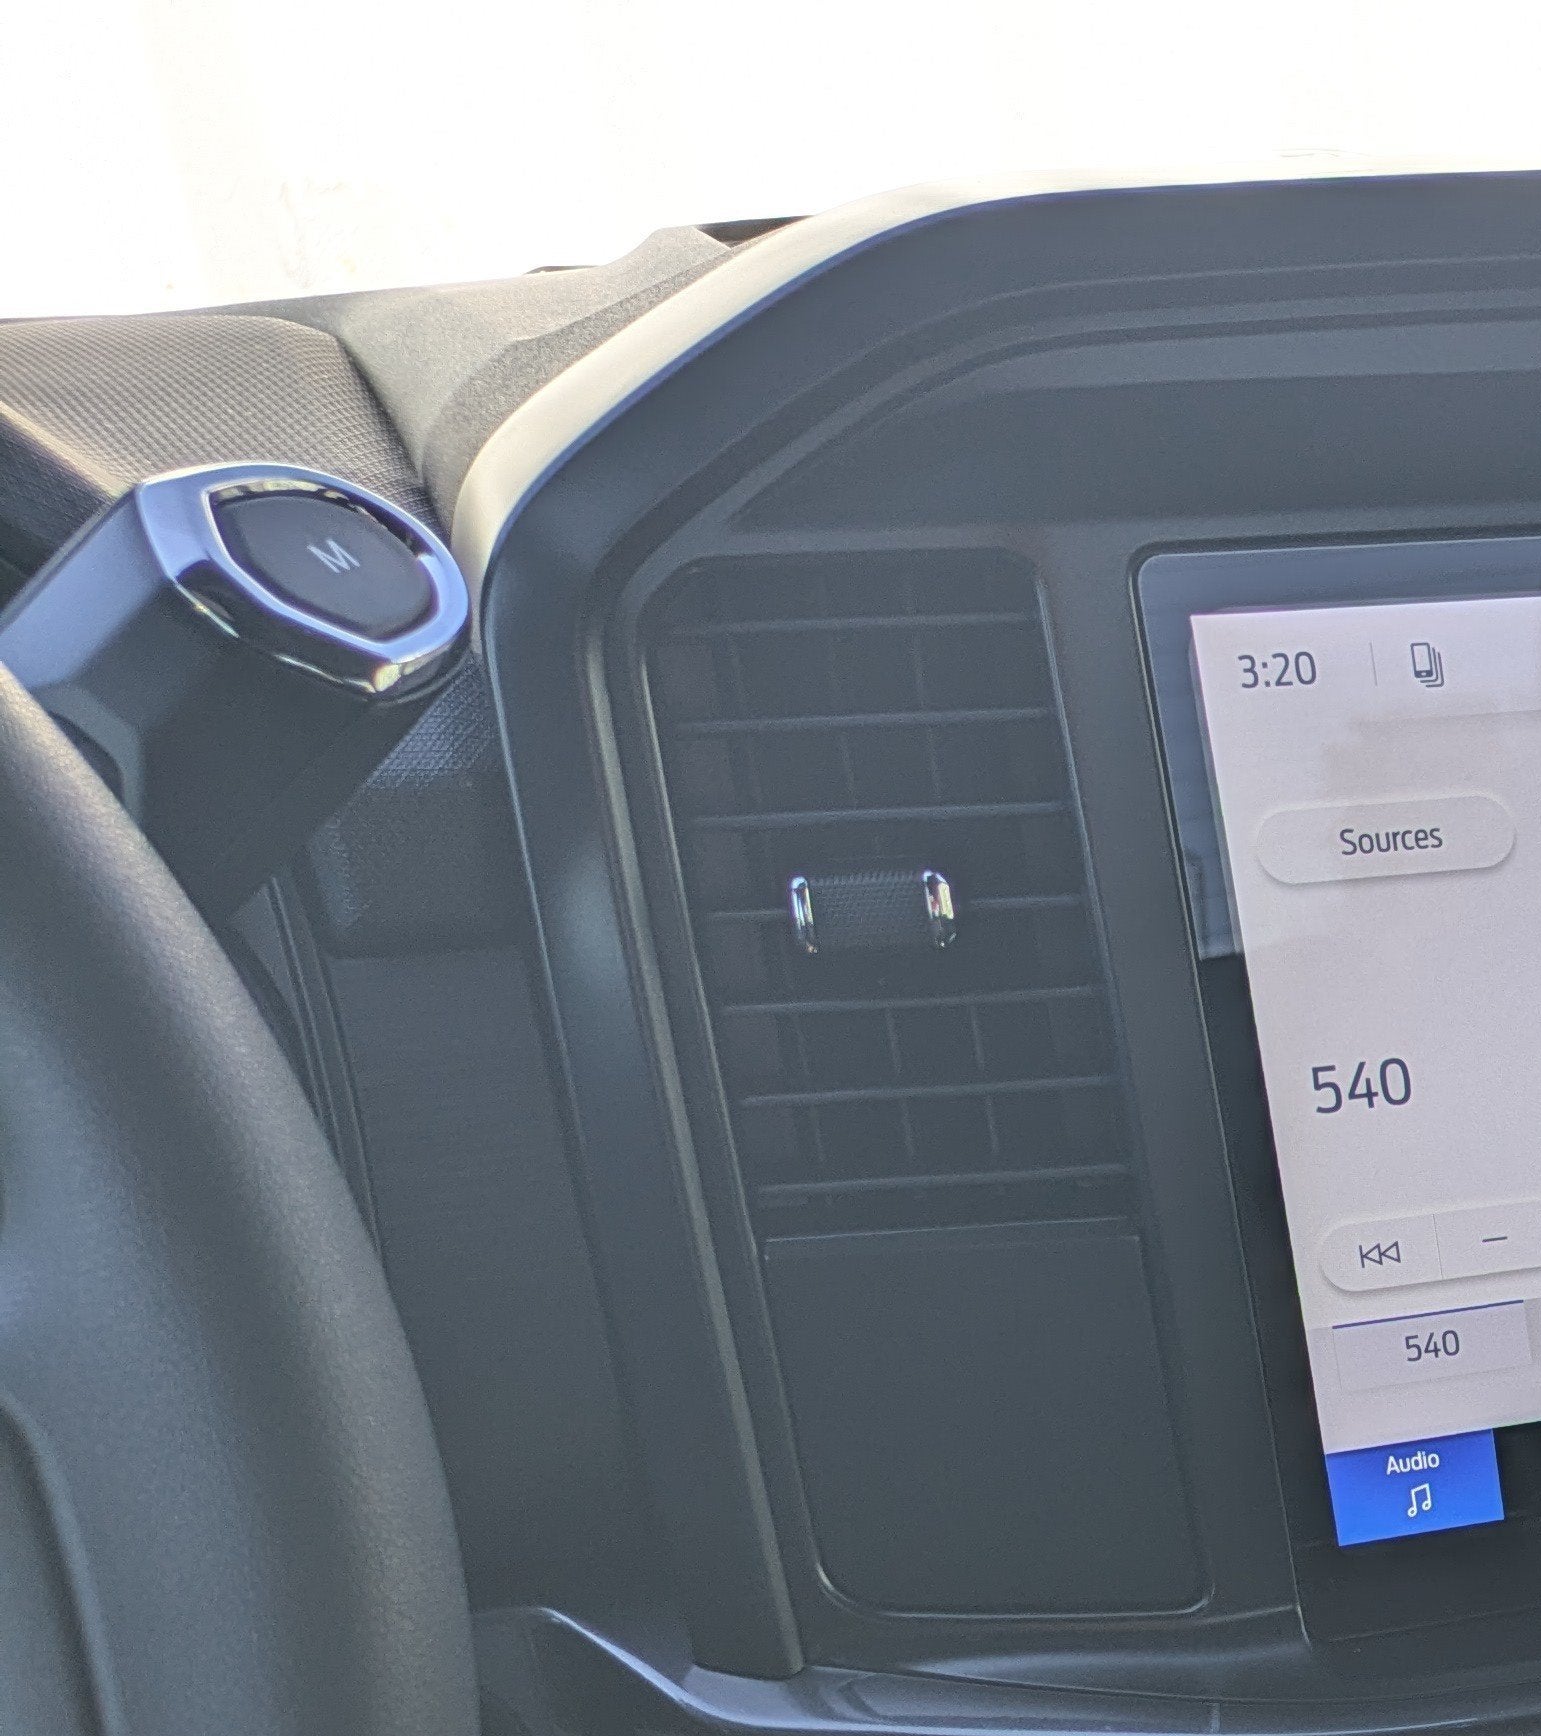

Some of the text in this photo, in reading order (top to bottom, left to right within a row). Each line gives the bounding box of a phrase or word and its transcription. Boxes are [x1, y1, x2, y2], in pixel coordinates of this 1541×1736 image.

[308, 539, 361, 574] M
[1237, 651, 1317, 689] 3:20
[1339, 827, 1443, 856] Sources
[1311, 1057, 1412, 1114] 540
[1404, 1329, 1460, 1362] 540
[1386, 1450, 1440, 1475] Audio
